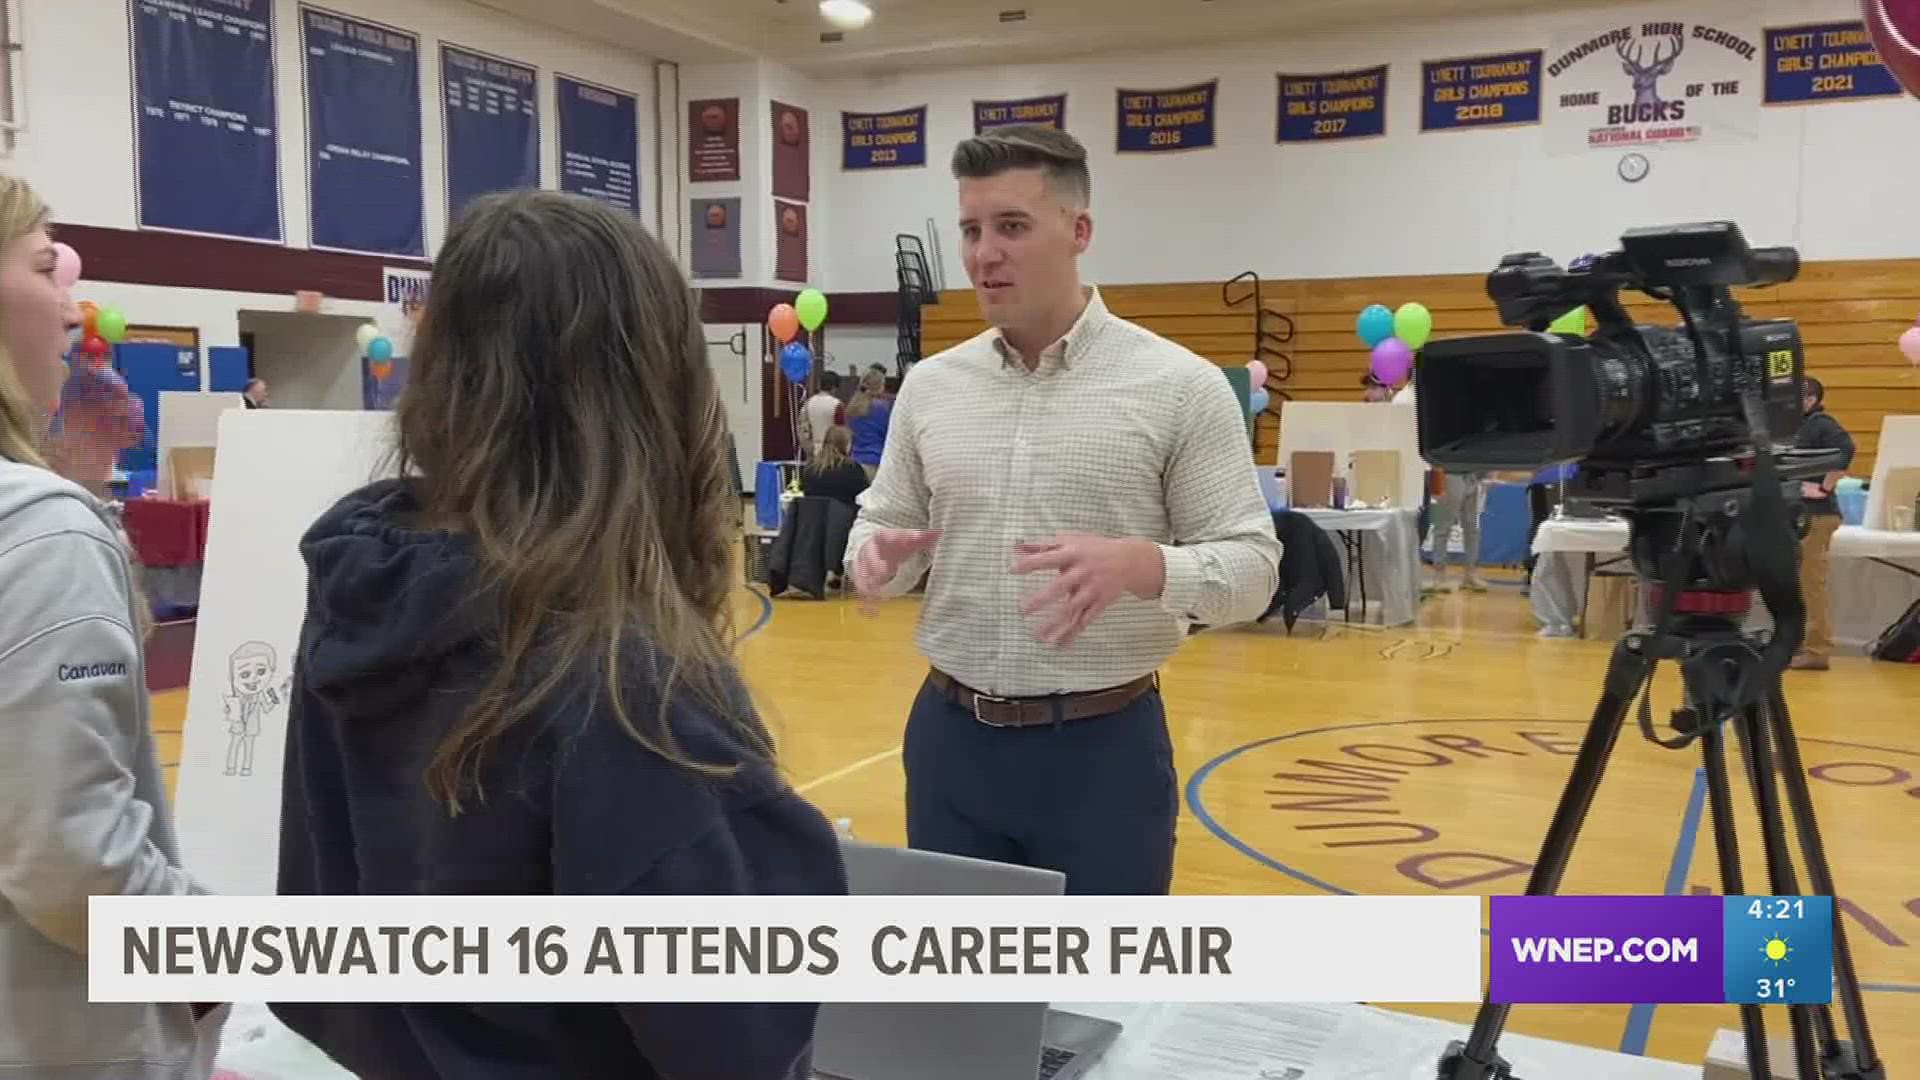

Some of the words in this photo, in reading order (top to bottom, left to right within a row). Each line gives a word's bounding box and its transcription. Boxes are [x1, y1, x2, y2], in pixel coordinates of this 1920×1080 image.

[1547, 26, 1632, 77] DUNMORE
[1641, 22, 1685, 37] HIGH
[1691, 25, 1758, 61] SCHOOL
[1774, 33, 1813, 51] LYNETT
[1431, 66, 1466, 82] LYNETT
[1470, 60, 1530, 79] TOURNAMENT
[1777, 53, 1814, 72] GIRLS
[1284, 80, 1316, 96] LYNETT
[1320, 75, 1379, 95] TOURNAMENT
[1434, 86, 1466, 102] GIRLS
[1468, 80, 1528, 99] CHAMPIONS
[1811, 75, 1854, 92] 2021
[1156, 90, 1207, 108] TOURNAMENT
[1560, 92, 1600, 107] HOME
[1686, 83, 1704, 97] OF
[1712, 81, 1740, 95] THE
[1287, 101, 1317, 115] GIRLS
[1319, 96, 1375, 113] CHAMPIONS
[1455, 103, 1504, 120] 2018
[1608, 100, 1686, 125] BUCKS
[1126, 113, 1153, 127] GIRLS
[1154, 108, 1205, 127] CHAMPIONS
[1312, 118, 1347, 134] 2017
[1150, 131, 1181, 145] 2016
[1588, 130, 1642, 144] NATIONAL
[1774, 353, 1790, 373] 16
[58, 662, 127, 681] Canavan
